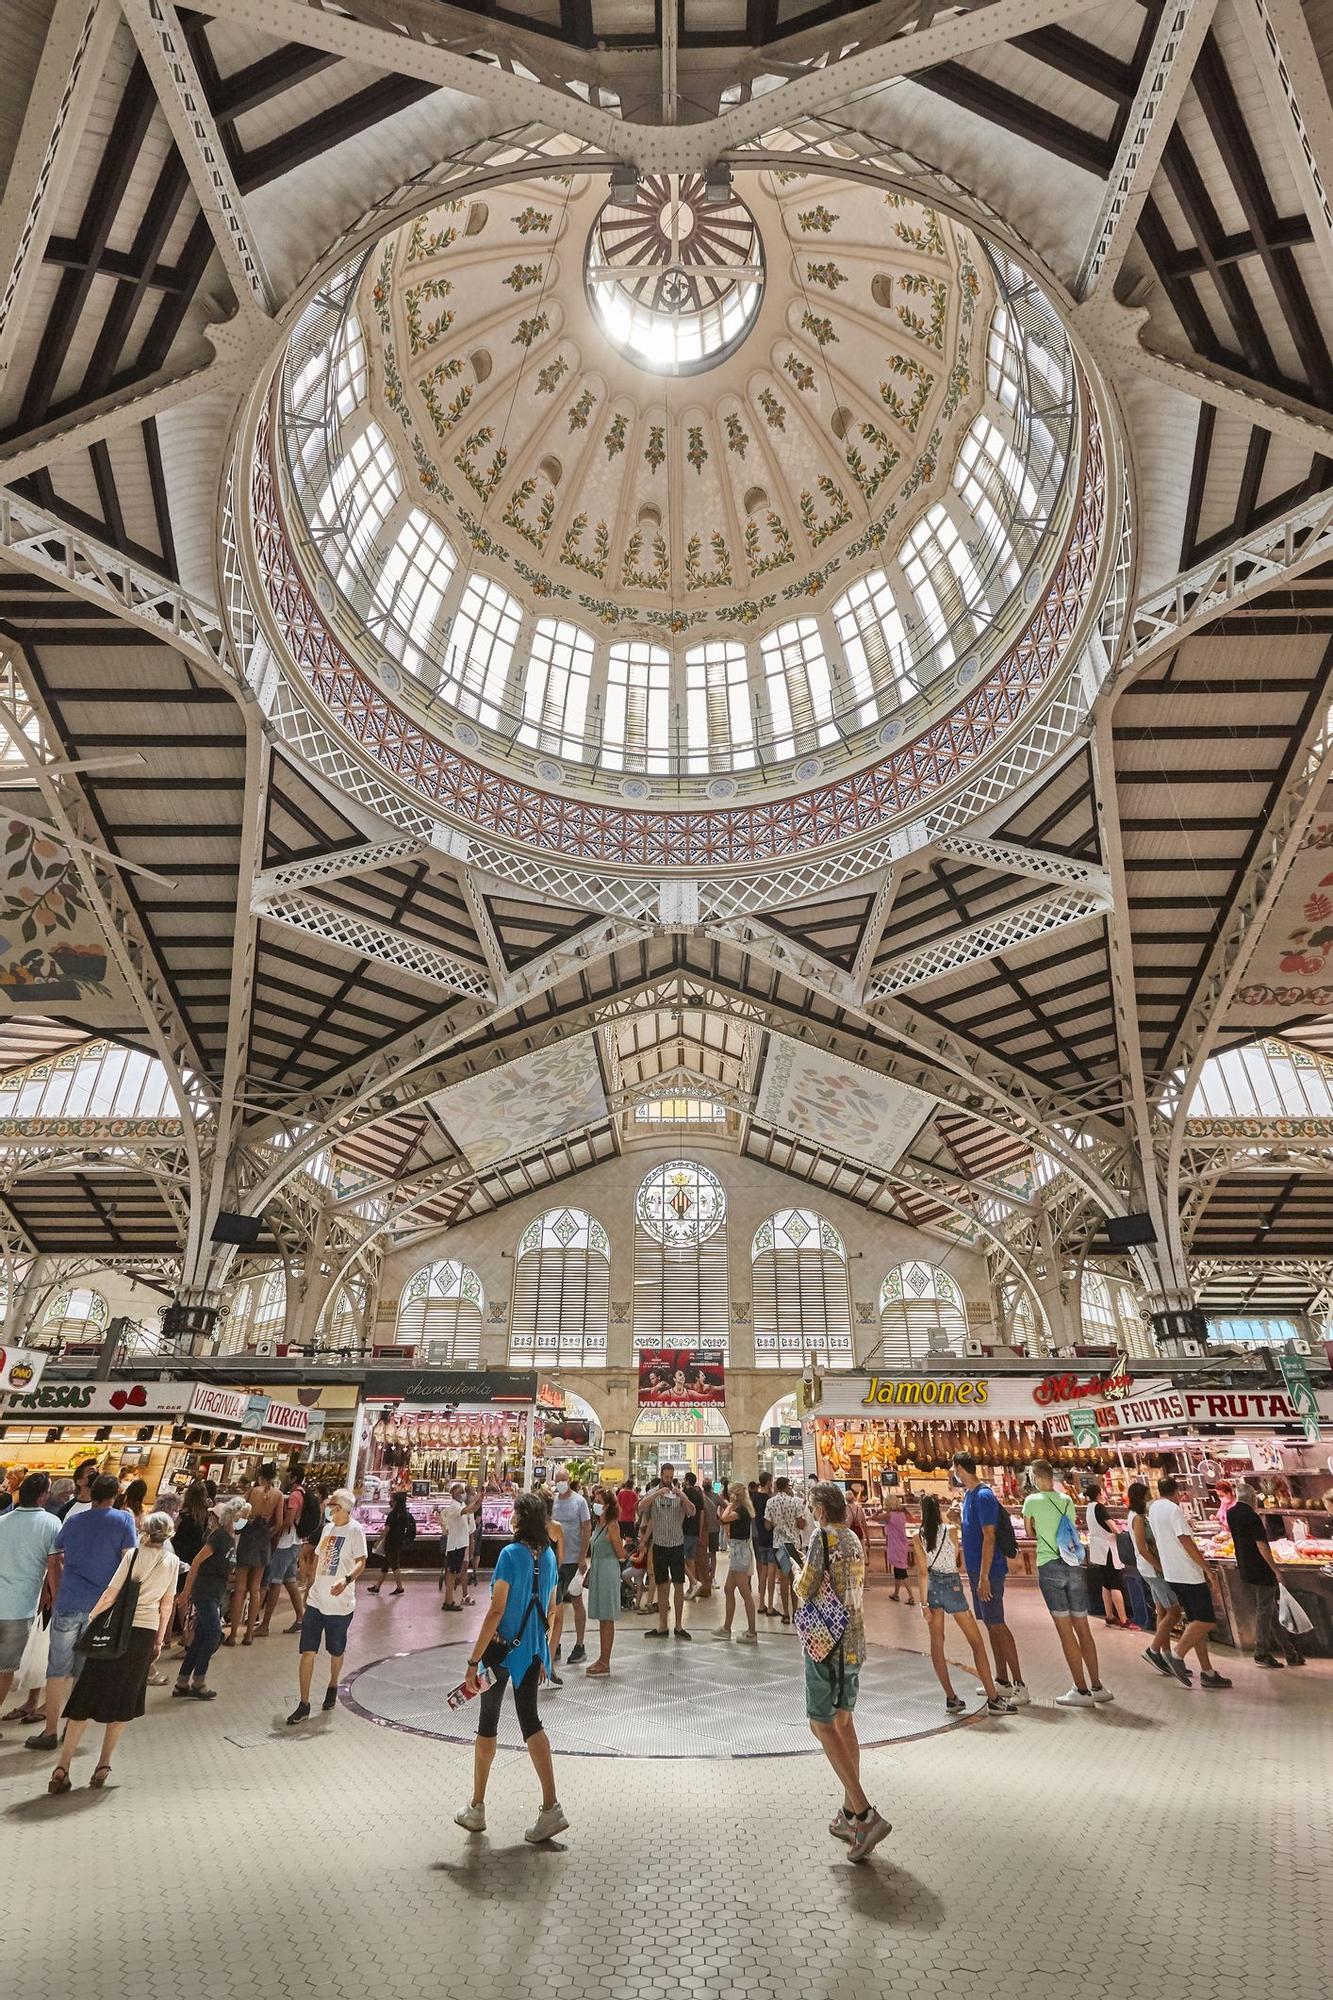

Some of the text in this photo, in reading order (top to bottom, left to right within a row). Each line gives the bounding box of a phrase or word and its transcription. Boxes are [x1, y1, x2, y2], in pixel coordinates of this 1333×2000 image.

[8, 1386, 96, 1409] FRESAS
[193, 1389, 239, 1417] VIRGINIA
[861, 1376, 989, 1404] Jamones
[267, 1404, 310, 1429] VIRGIN
[679, 1399, 725, 1408] EMOCIÓN
[1121, 1395, 1185, 1424] FRUTAS
